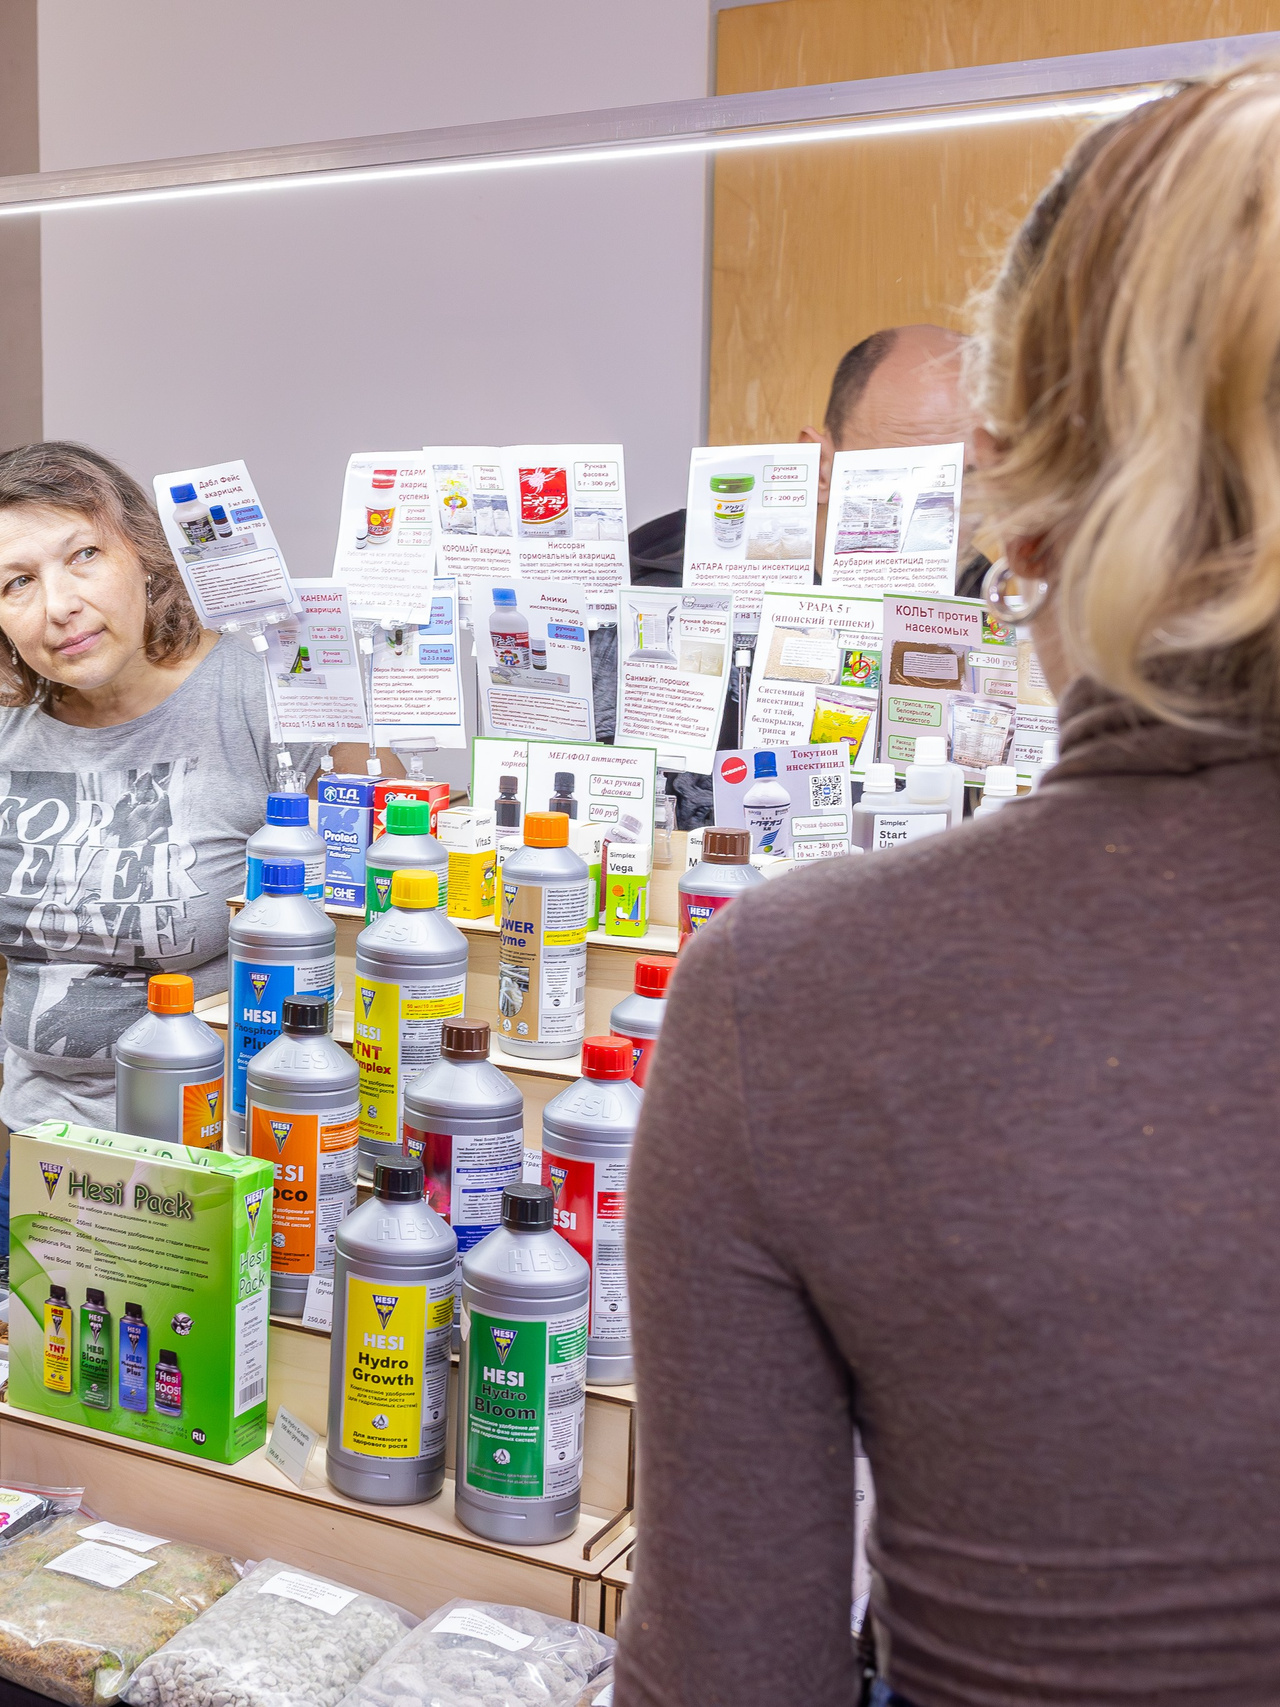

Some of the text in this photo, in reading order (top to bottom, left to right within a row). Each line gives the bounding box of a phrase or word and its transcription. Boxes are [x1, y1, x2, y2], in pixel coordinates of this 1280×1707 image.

[199, 475, 241, 490] Дабл Фейс
[205, 486, 243, 499] акарицид
[237, 514, 258, 522] фасовка
[443, 544, 510, 555] КОРОМАЙТ акарицид
[548, 542, 585, 550] Ниссоран
[691, 563, 722, 571] АКТАРА
[725, 564, 759, 572] гранулы
[834, 559, 872, 567] Арубарин
[301, 593, 342, 601] КАНЕМАЙТ
[541, 595, 567, 603] Аники
[799, 602, 842, 613] УРАРА 5
[896, 605, 978, 622] КОЛЬТ против
[772, 615, 875, 629] (японский теппеки)
[906, 623, 969, 636] насекомых
[555, 632, 578, 640] фасовка
[626, 674, 689, 686] Санмайт, порошок
[759, 686, 804, 696] Системный
[757, 698, 804, 707] инсектицид
[774, 708, 794, 716] тлей,
[896, 708, 932, 717] белокрылки,
[752, 715, 804, 727] белокрылки,
[898, 716, 930, 724] мучнистого
[758, 727, 786, 736] трипса
[762, 736, 789, 746] других
[548, 752, 638, 765] МЕГАФОЛ антистресс
[791, 749, 838, 759] Токутион
[786, 761, 845, 771] инсектицид
[615, 779, 640, 788] ручная
[337, 788, 359, 800] T.A.
[601, 788, 631, 796] фасовка
[603, 809, 618, 817] руб
[324, 830, 358, 844] Protect
[880, 830, 907, 839] Start
[610, 863, 633, 873] Vega
[334, 888, 355, 899] GHE
[690, 907, 709, 916] HESI
[244, 1008, 276, 1024] HESI
[356, 1022, 381, 1041] HESI
[244, 1037, 269, 1050] Plu
[356, 1040, 382, 1060] TNT
[353, 1054, 391, 1074] omplex
[201, 1121, 221, 1138] HESI
[272, 1122, 290, 1130] HESI
[407, 1140, 423, 1151] HESI
[41, 1162, 61, 1173] HESI
[551, 1168, 566, 1177] HESI
[68, 1171, 192, 1220] Hesi Pack
[50, 1213, 91, 1227] Complex 250ml
[32, 1222, 71, 1236] Bloom Complex
[29, 1235, 92, 1253] Phosphorus 250ml
[240, 1243, 267, 1275] Hesi
[239, 1270, 266, 1299] Pack
[319, 1279, 332, 1287] Hesi
[375, 1296, 395, 1304] HESI
[308, 1316, 326, 1325] 250,00
[494, 1330, 514, 1338] HESI
[364, 1333, 404, 1350] HESI
[49, 1344, 65, 1354] TNT
[87, 1345, 104, 1355] HESI
[82, 1352, 108, 1365] Bloom
[126, 1354, 141, 1363] HESI
[359, 1352, 408, 1369] Hydro
[160, 1371, 178, 1384] Hesi
[353, 1368, 414, 1386] Growth
[483, 1366, 524, 1387] HESI
[155, 1382, 181, 1395] BOOST
[350, 1384, 384, 1396] Комплексное
[482, 1384, 527, 1401] Hydro
[474, 1396, 537, 1420] Bloom
[193, 1432, 205, 1442] RU
[367, 1434, 401, 1443] активного
[353, 1439, 386, 1448] здорового
